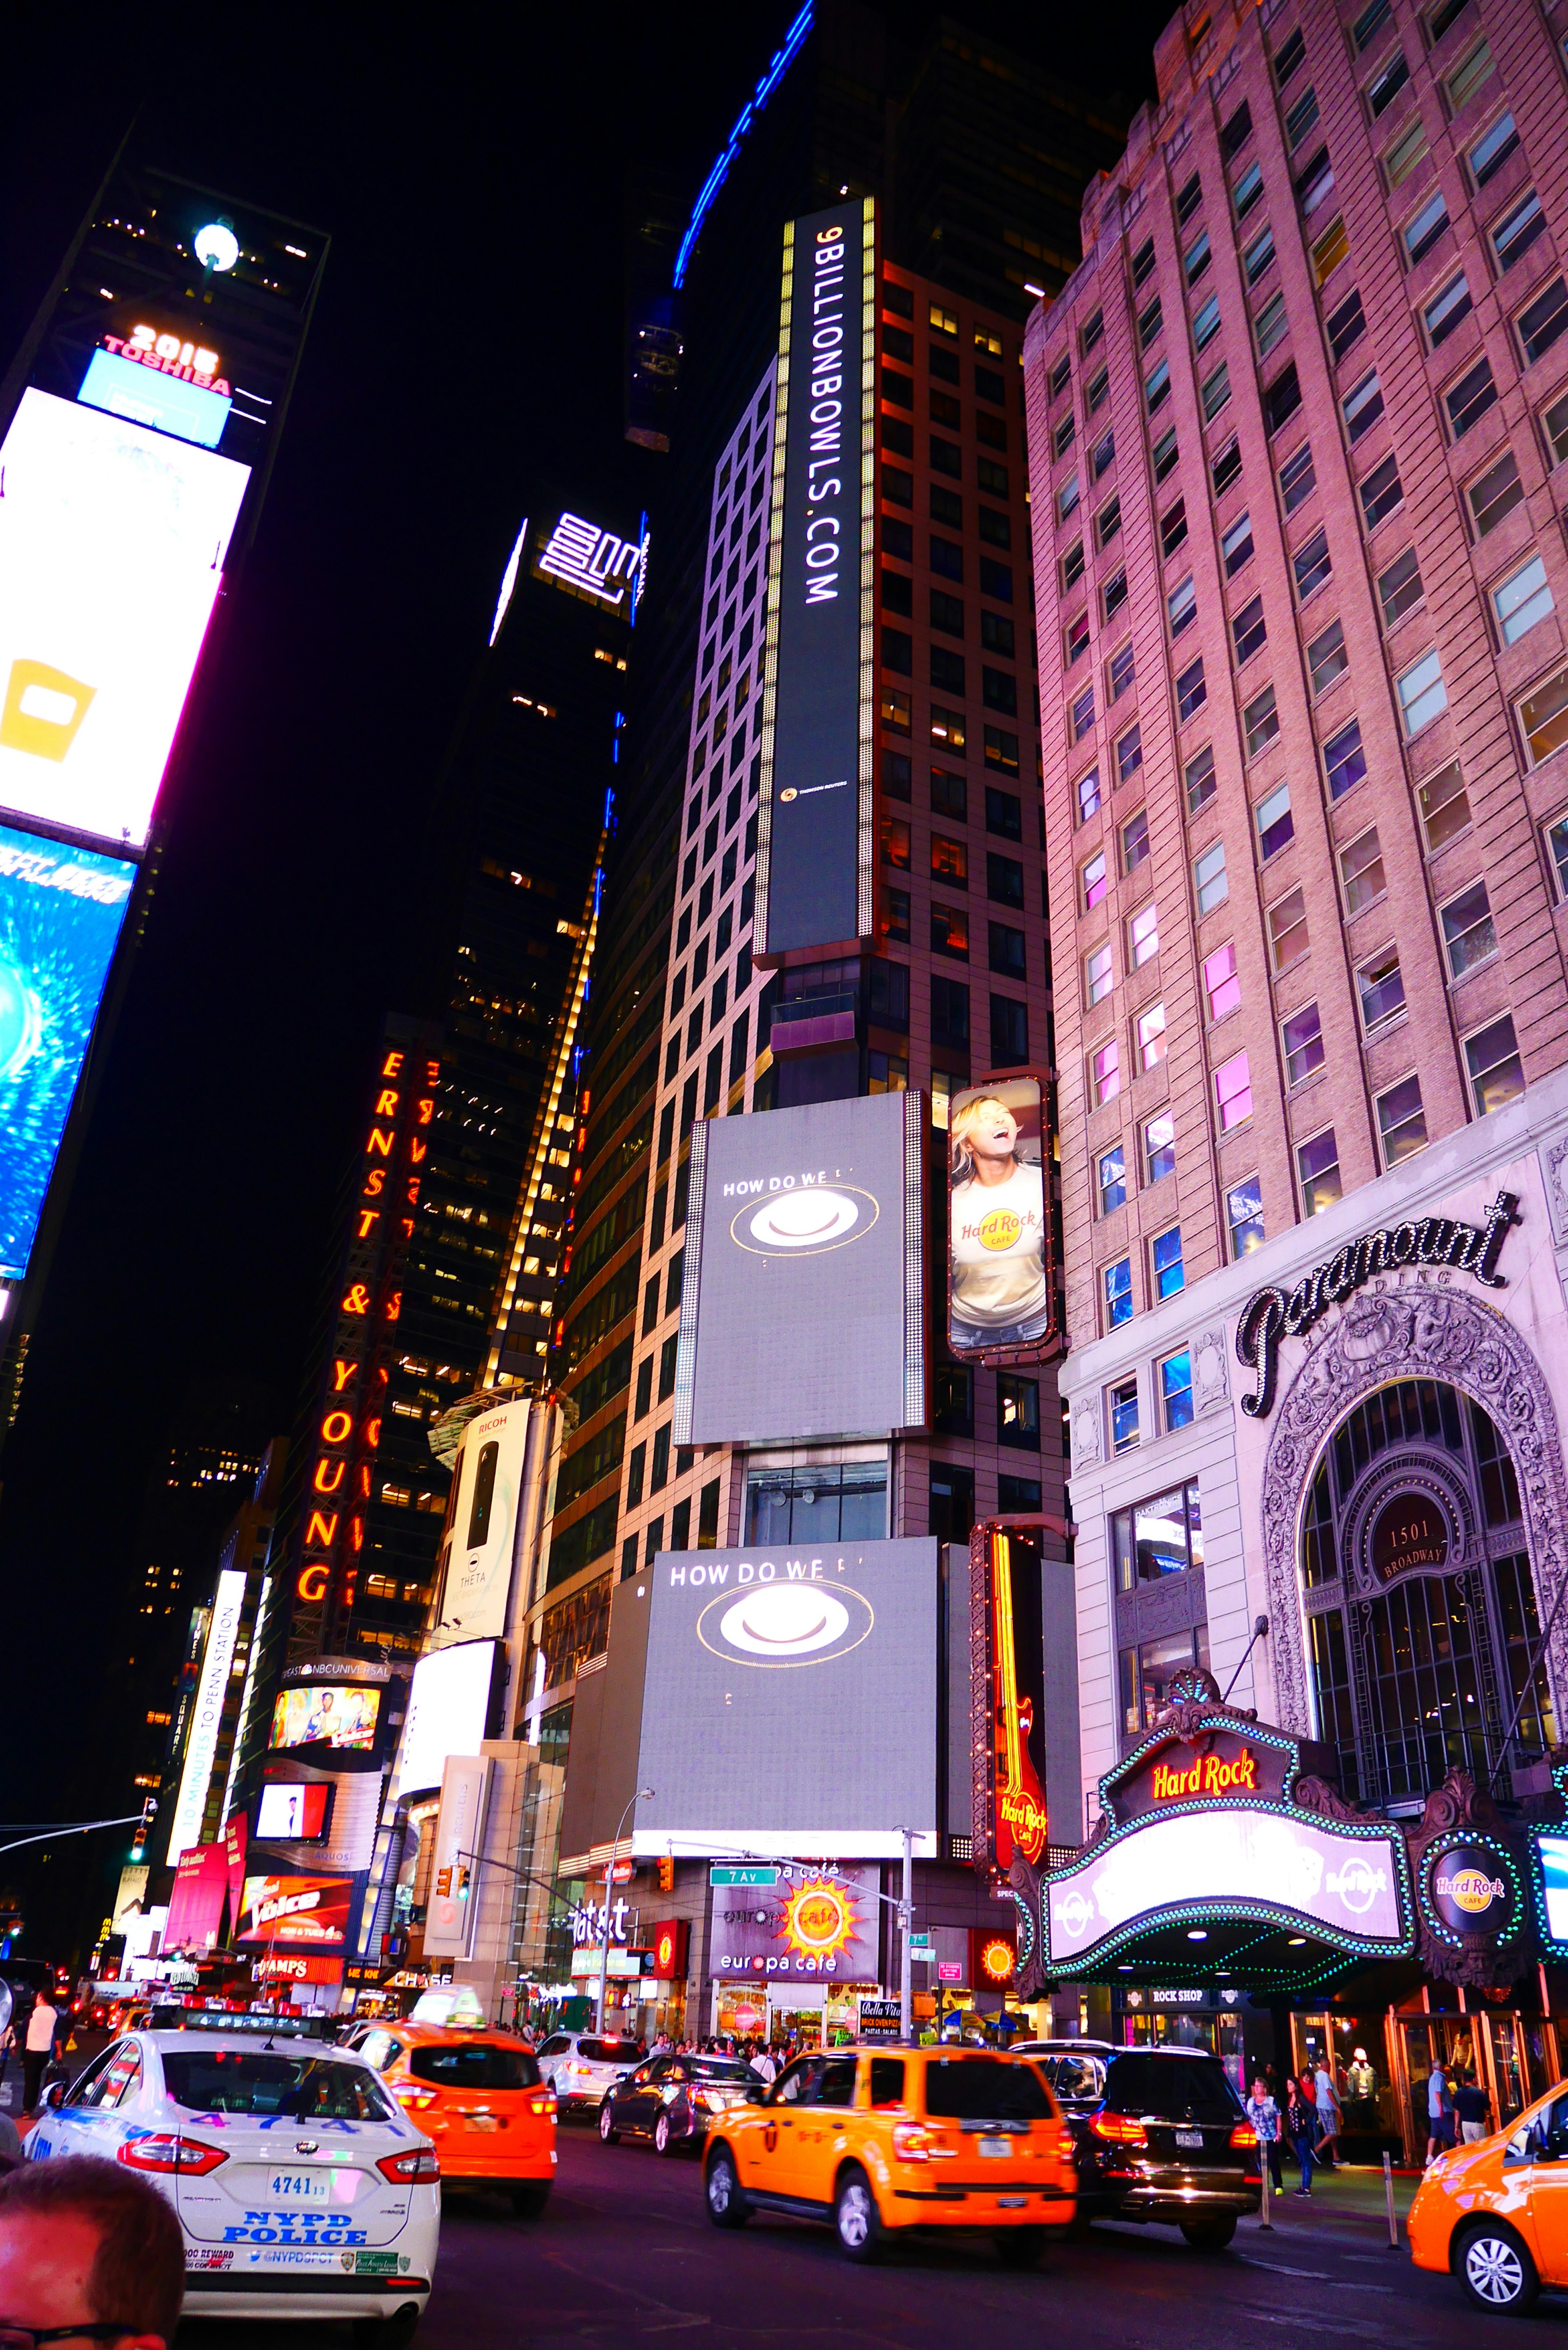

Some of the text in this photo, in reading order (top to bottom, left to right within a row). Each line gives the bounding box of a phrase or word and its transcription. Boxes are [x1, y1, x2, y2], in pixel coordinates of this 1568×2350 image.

[105, 334, 231, 397] TOSHIBA
[805, 227, 844, 604] 9BILLIONBOWLS.COM
[724, 1179, 764, 1196] HOW
[769, 1176, 795, 1190] DO
[801, 1171, 826, 1185] WE
[962, 1210, 1036, 1240] Hard Rock
[991, 1236, 1011, 1244] CAFE
[1236, 1190, 1522, 1418] Paramount
[298, 1052, 404, 1601] ERNST & YOUNG
[479, 1416, 507, 1434] RICOH
[1391, 1520, 1428, 1548] 1501
[671, 1559, 823, 1586] HOW DO WE
[1384, 1549, 1442, 1578] BROADWAY
[461, 1572, 485, 1588] THETA
[191, 1610, 204, 1659] TIMES
[312, 1664, 388, 1677] NBCUNIVERSAL
[172, 1695, 187, 1755] SQUARE
[183, 1608, 234, 1826] 10 MINUTES TO PENN STATION
[1154, 1749, 1255, 1798] Hard Rock
[1001, 1797, 1047, 1836] Hard Rock
[1019, 1829, 1032, 1842] CAFE
[314, 1852, 349, 1861] AQUOS
[729, 1871, 756, 1882] 7 Av
[1437, 1878, 1505, 1898] Hard Rock
[913, 1936, 917, 1945] 7
[796, 1954, 836, 1971] café
[348, 1968, 360, 1978] WE
[1153, 1991, 1178, 2002] ROCK
[1178, 1990, 1203, 2001] SHOP
[862, 2002, 901, 2016] Bella Vita
[861, 2018, 875, 2026] BRICK
[875, 2018, 888, 2027] OVEN
[272, 2176, 325, 2195] 4741 13
[243, 2212, 353, 2227] NYPD
[223, 2227, 368, 2245] POLICE
[201, 2250, 234, 2259] REWARD
